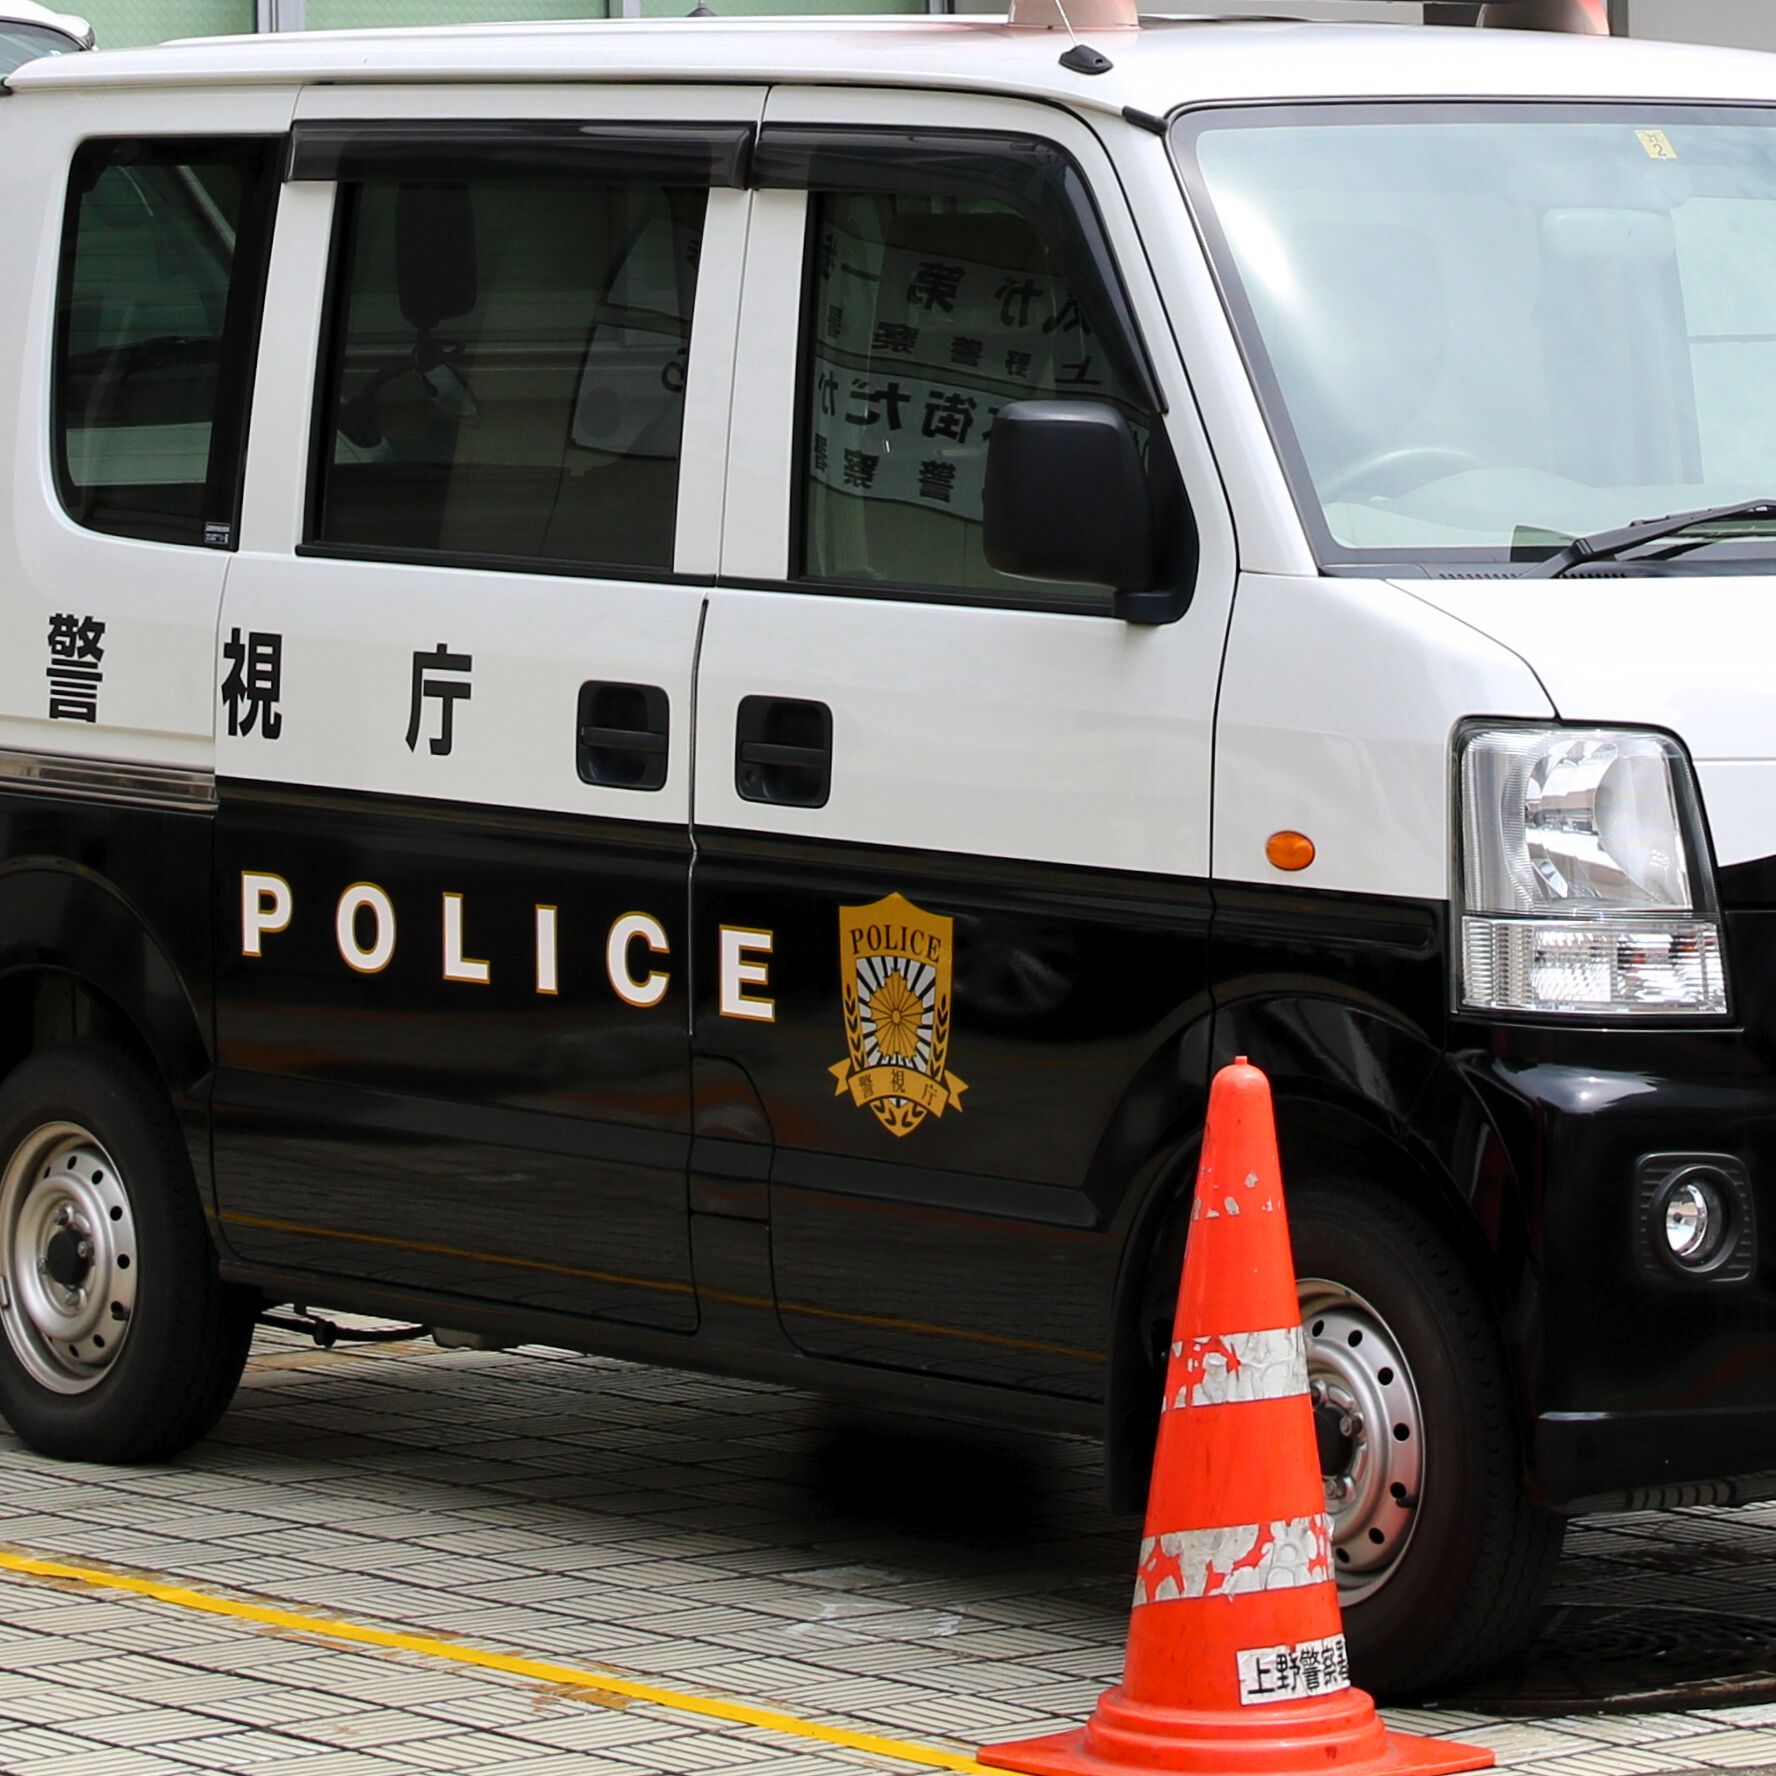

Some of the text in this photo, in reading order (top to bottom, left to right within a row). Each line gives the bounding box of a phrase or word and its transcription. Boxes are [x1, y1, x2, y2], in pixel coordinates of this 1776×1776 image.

[46, 612, 472, 757] 警視庁
[240, 870, 776, 1023] POLICE
[850, 923, 942, 964] POLICE
[858, 1068, 939, 1108] 警視庁
